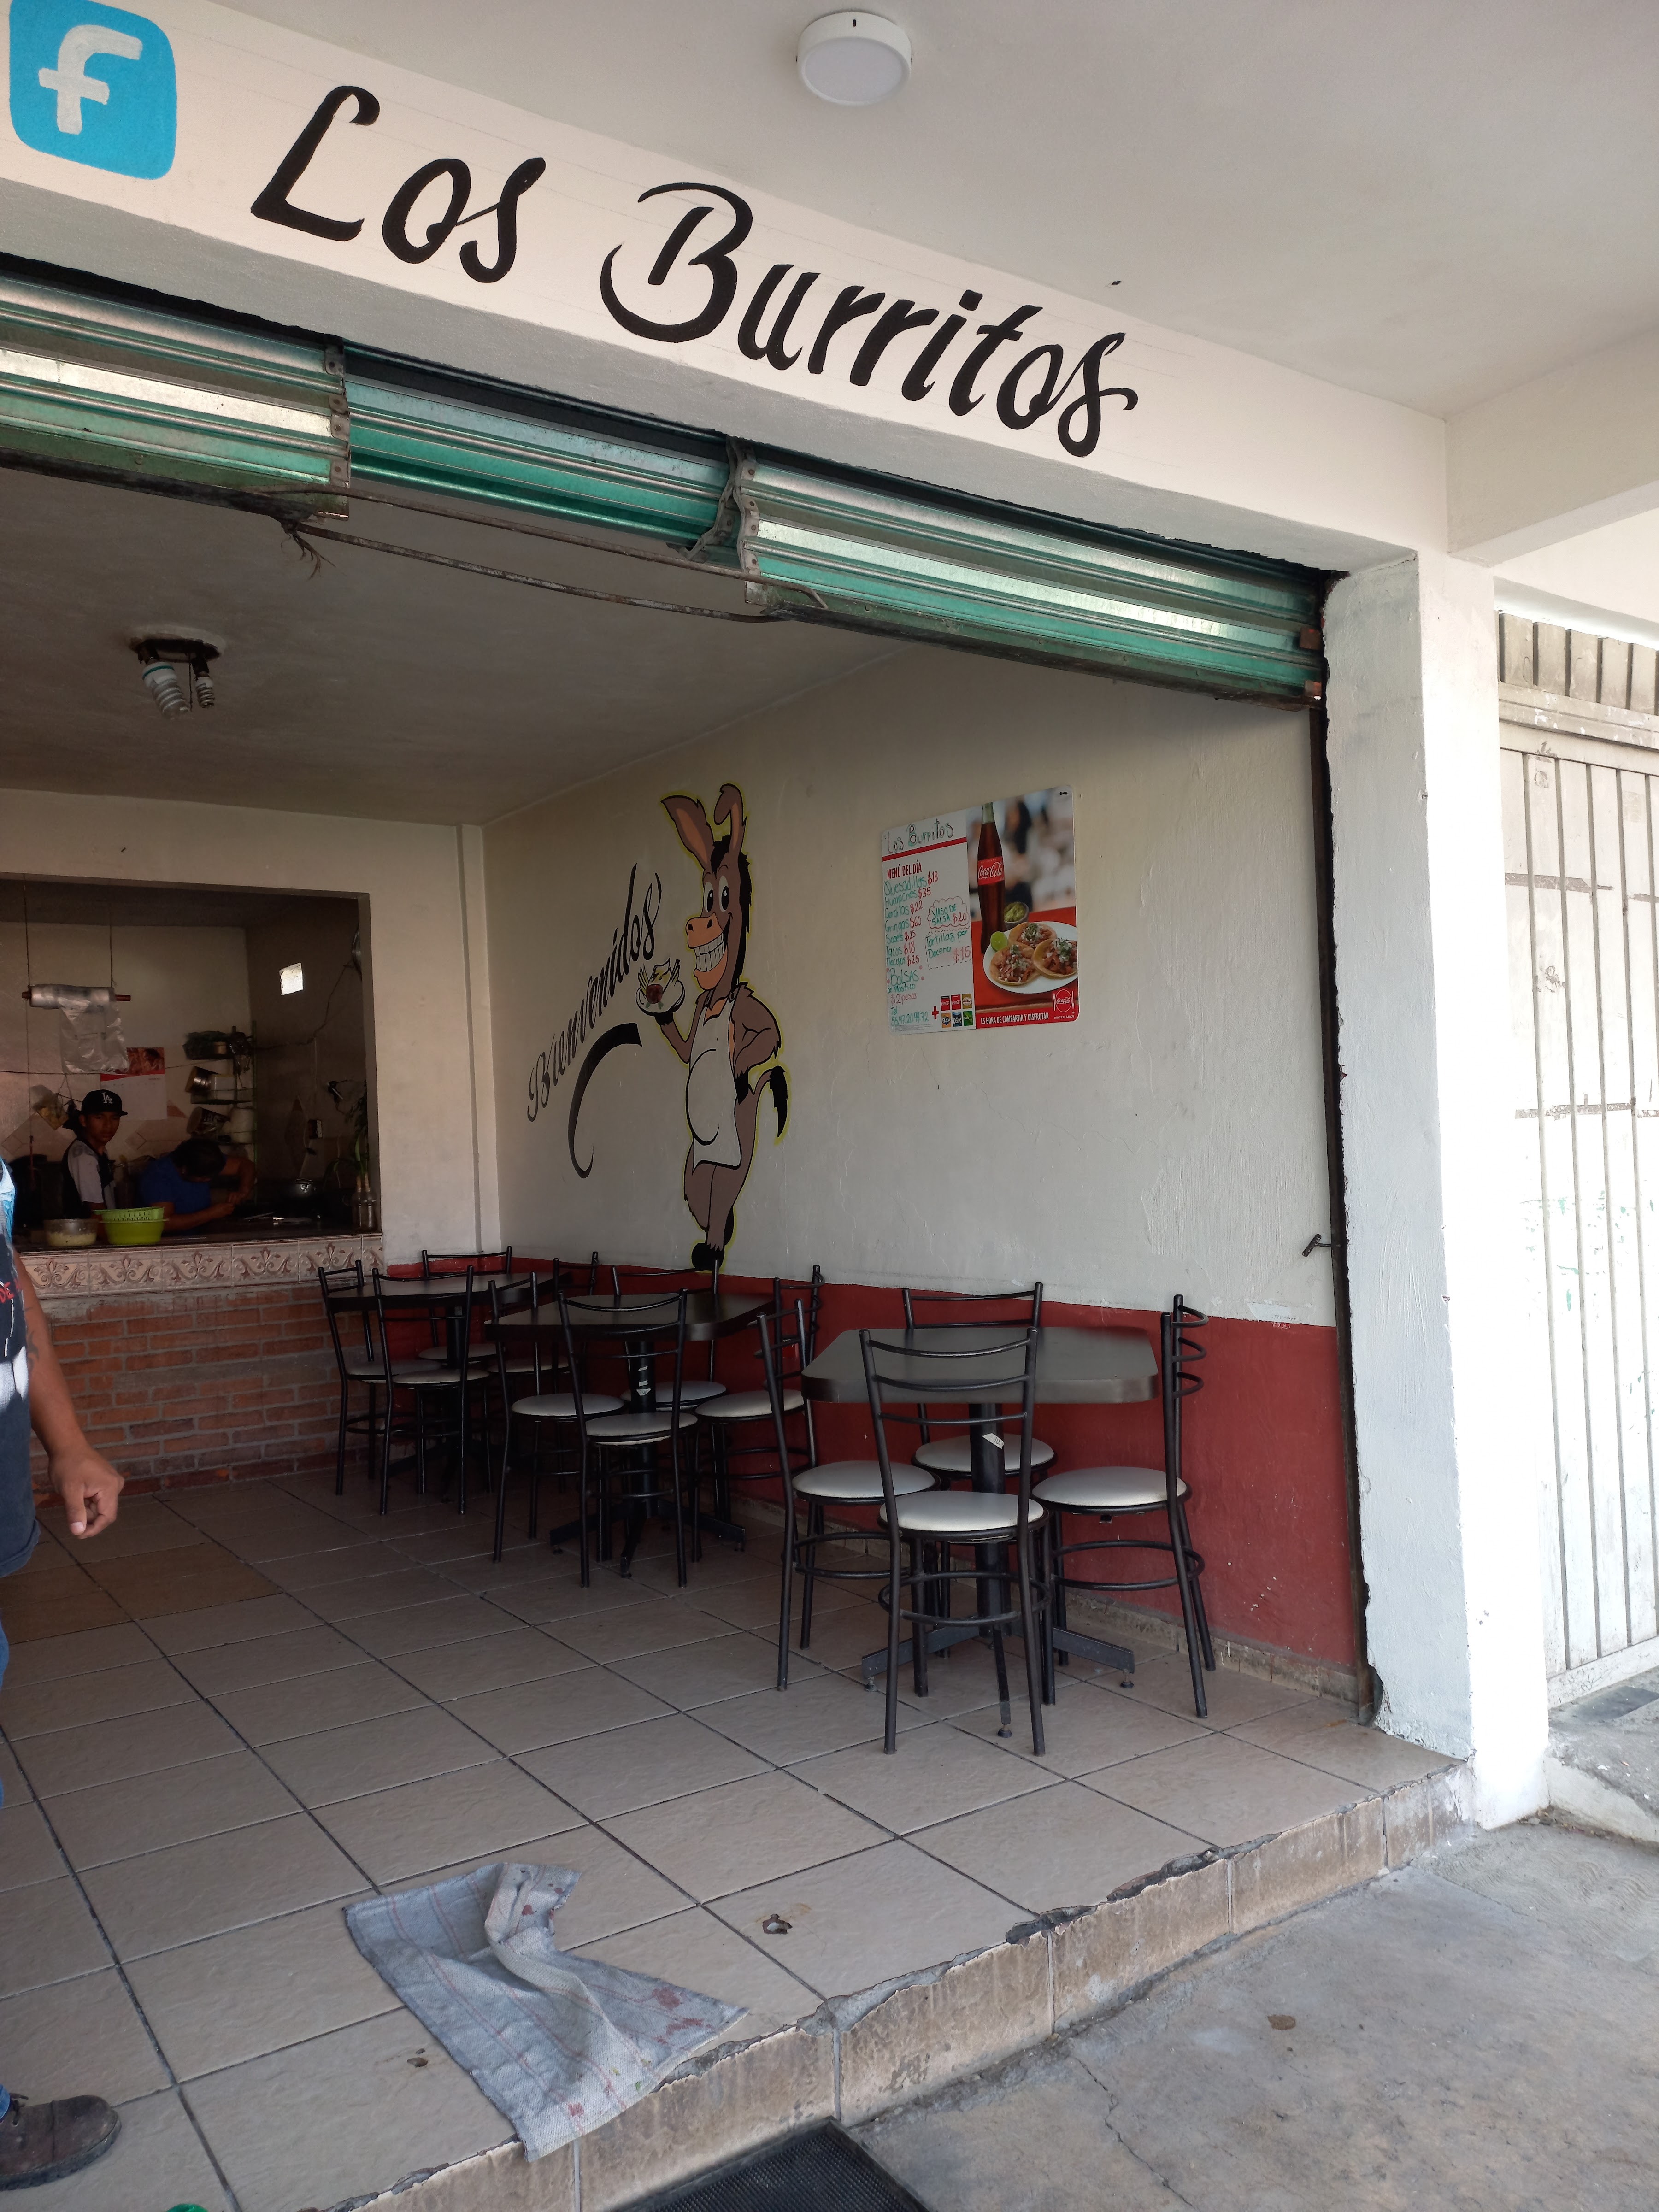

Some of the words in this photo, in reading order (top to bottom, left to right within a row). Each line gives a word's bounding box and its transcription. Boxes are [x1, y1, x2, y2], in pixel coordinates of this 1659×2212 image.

[251, 86, 546, 283] Los
[600, 182, 1138, 457] Burritos
[888, 831, 904, 853] Los
[906, 818, 953, 847] Burritos
[887, 863, 900, 880] MENÚ
[902, 864, 912, 877] DEL
[913, 859, 922, 874] DÍA
[978, 861, 1002, 880] Coca-Cola
[884, 876, 927, 896] Quesadillas
[928, 871, 938, 886] $18
[918, 887, 931, 900] $35
[910, 900, 923, 915] $22
[931, 906, 948, 918] VASO
[949, 903, 956, 912] DE
[910, 916, 922, 929] $60
[931, 914, 951, 925] SALSA
[953, 912, 967, 924] $20
[905, 930, 916, 941] $25
[925, 932, 955, 947] Tortillas
[886, 945, 902, 957] Tacos
[904, 941, 915, 955] $18
[928, 946, 951, 959] Docena
[953, 945, 971, 963] $15
[906, 954, 920, 967] $25
[527, 862, 662, 1122] Bienvenidos
[888, 985, 893, 994] de
[1002, 1014, 1024, 1024] COMPARTIR
[1028, 1012, 1049, 1021] DISFRUTAR
[101, 1092, 113, 1104] LA
